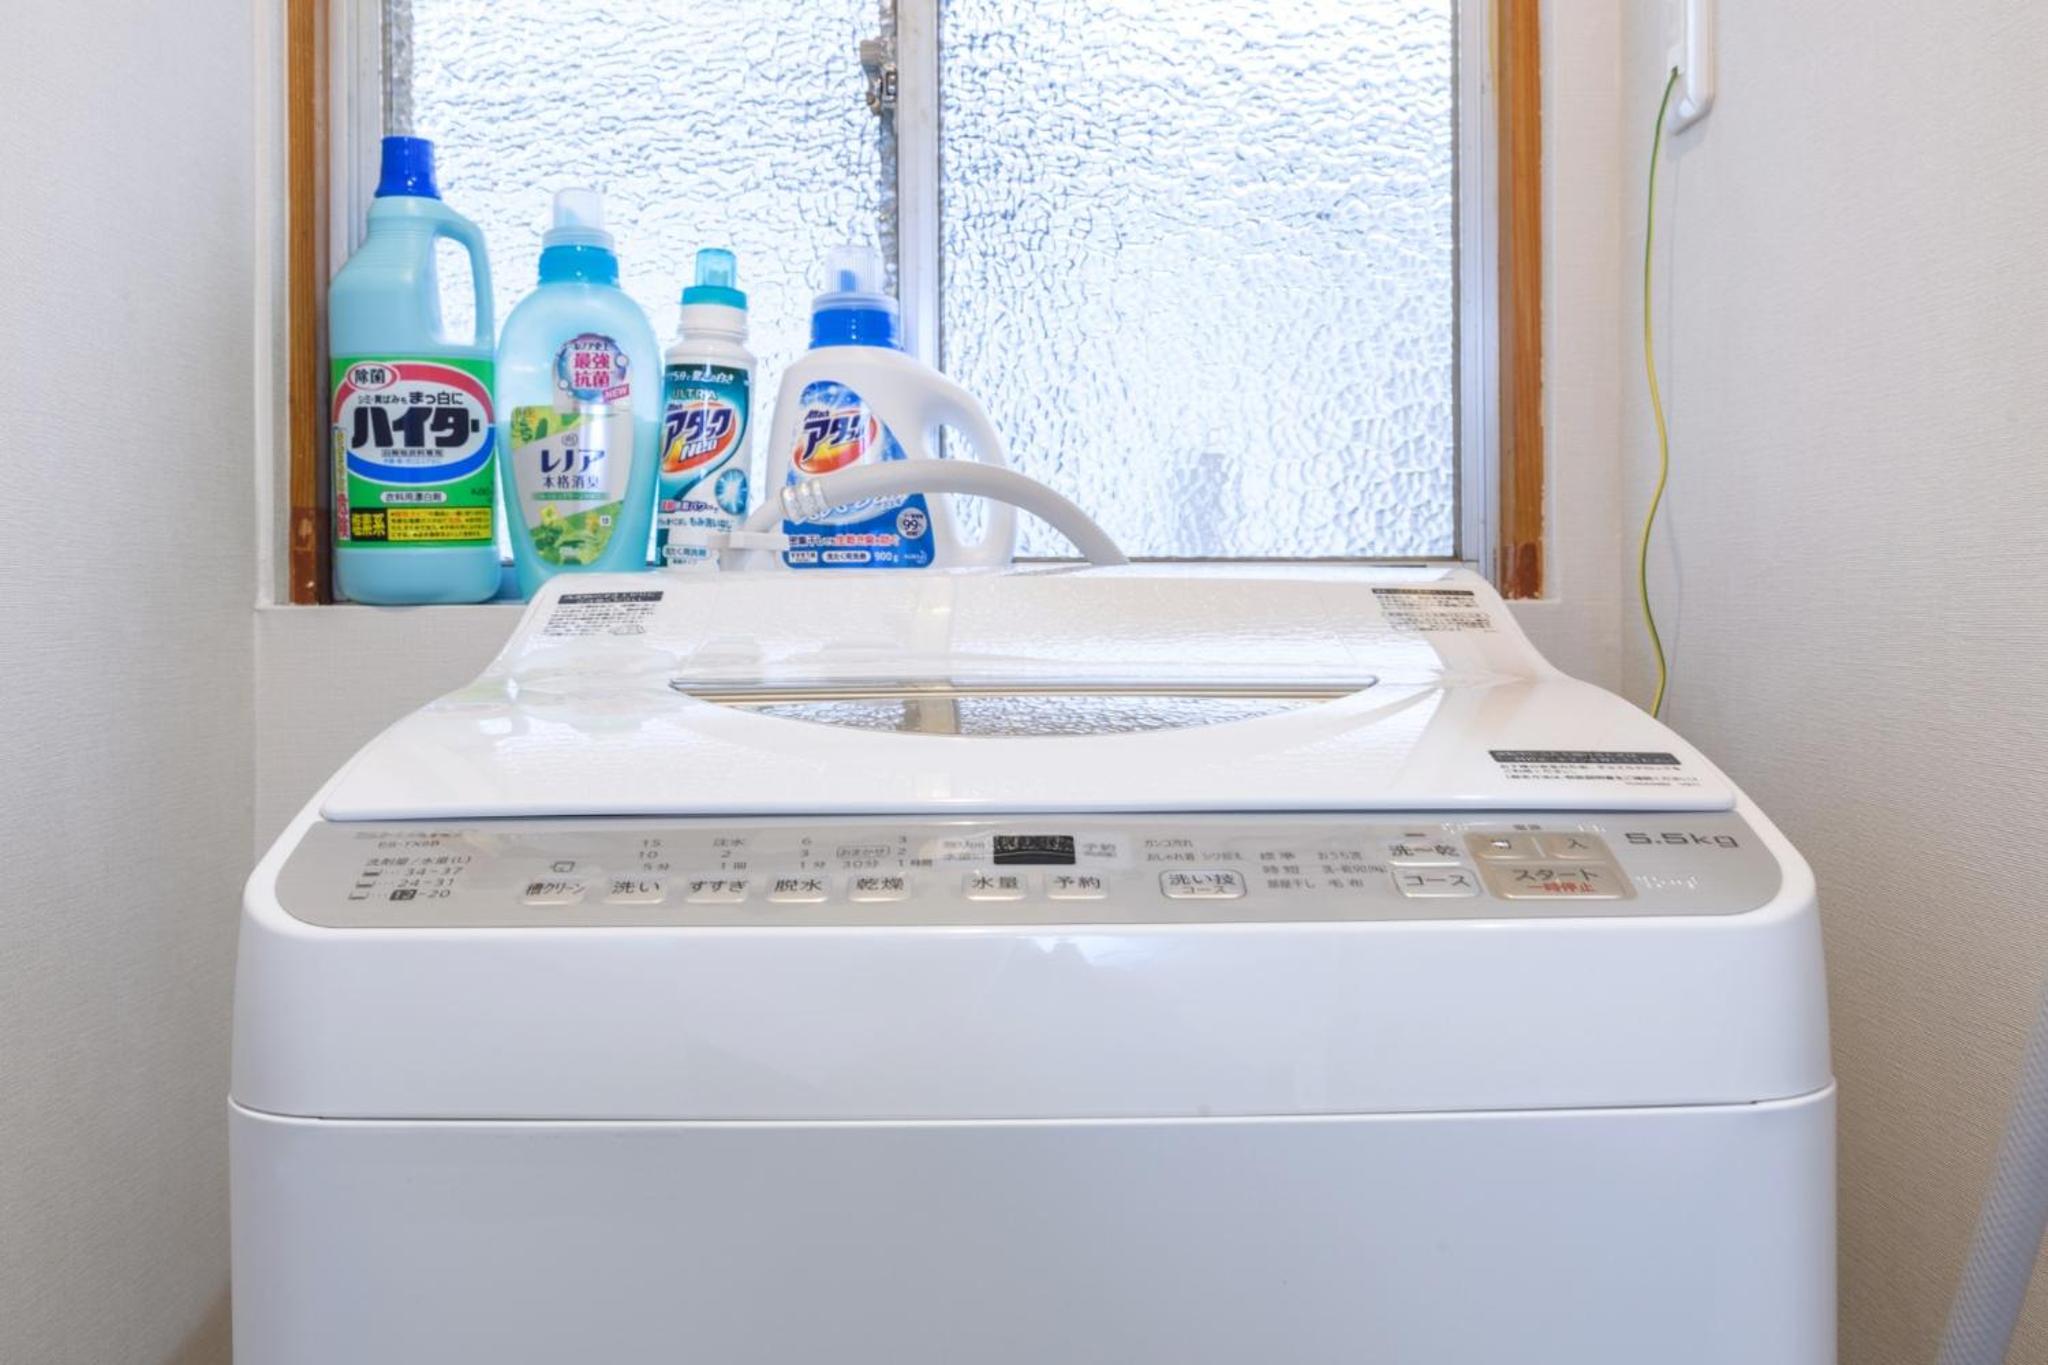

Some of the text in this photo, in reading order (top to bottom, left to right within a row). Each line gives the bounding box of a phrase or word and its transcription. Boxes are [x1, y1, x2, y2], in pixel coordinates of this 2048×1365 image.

[574, 353, 610, 369] 最強
[354, 368, 386, 385] 除菌
[574, 371, 610, 388] 抗菌
[351, 406, 480, 449] ハイター
[540, 449, 606, 474] レノア
[1623, 831, 1740, 849] 5.5kg
[1404, 874, 1472, 888] コース
[1512, 868, 1600, 882] スタート
